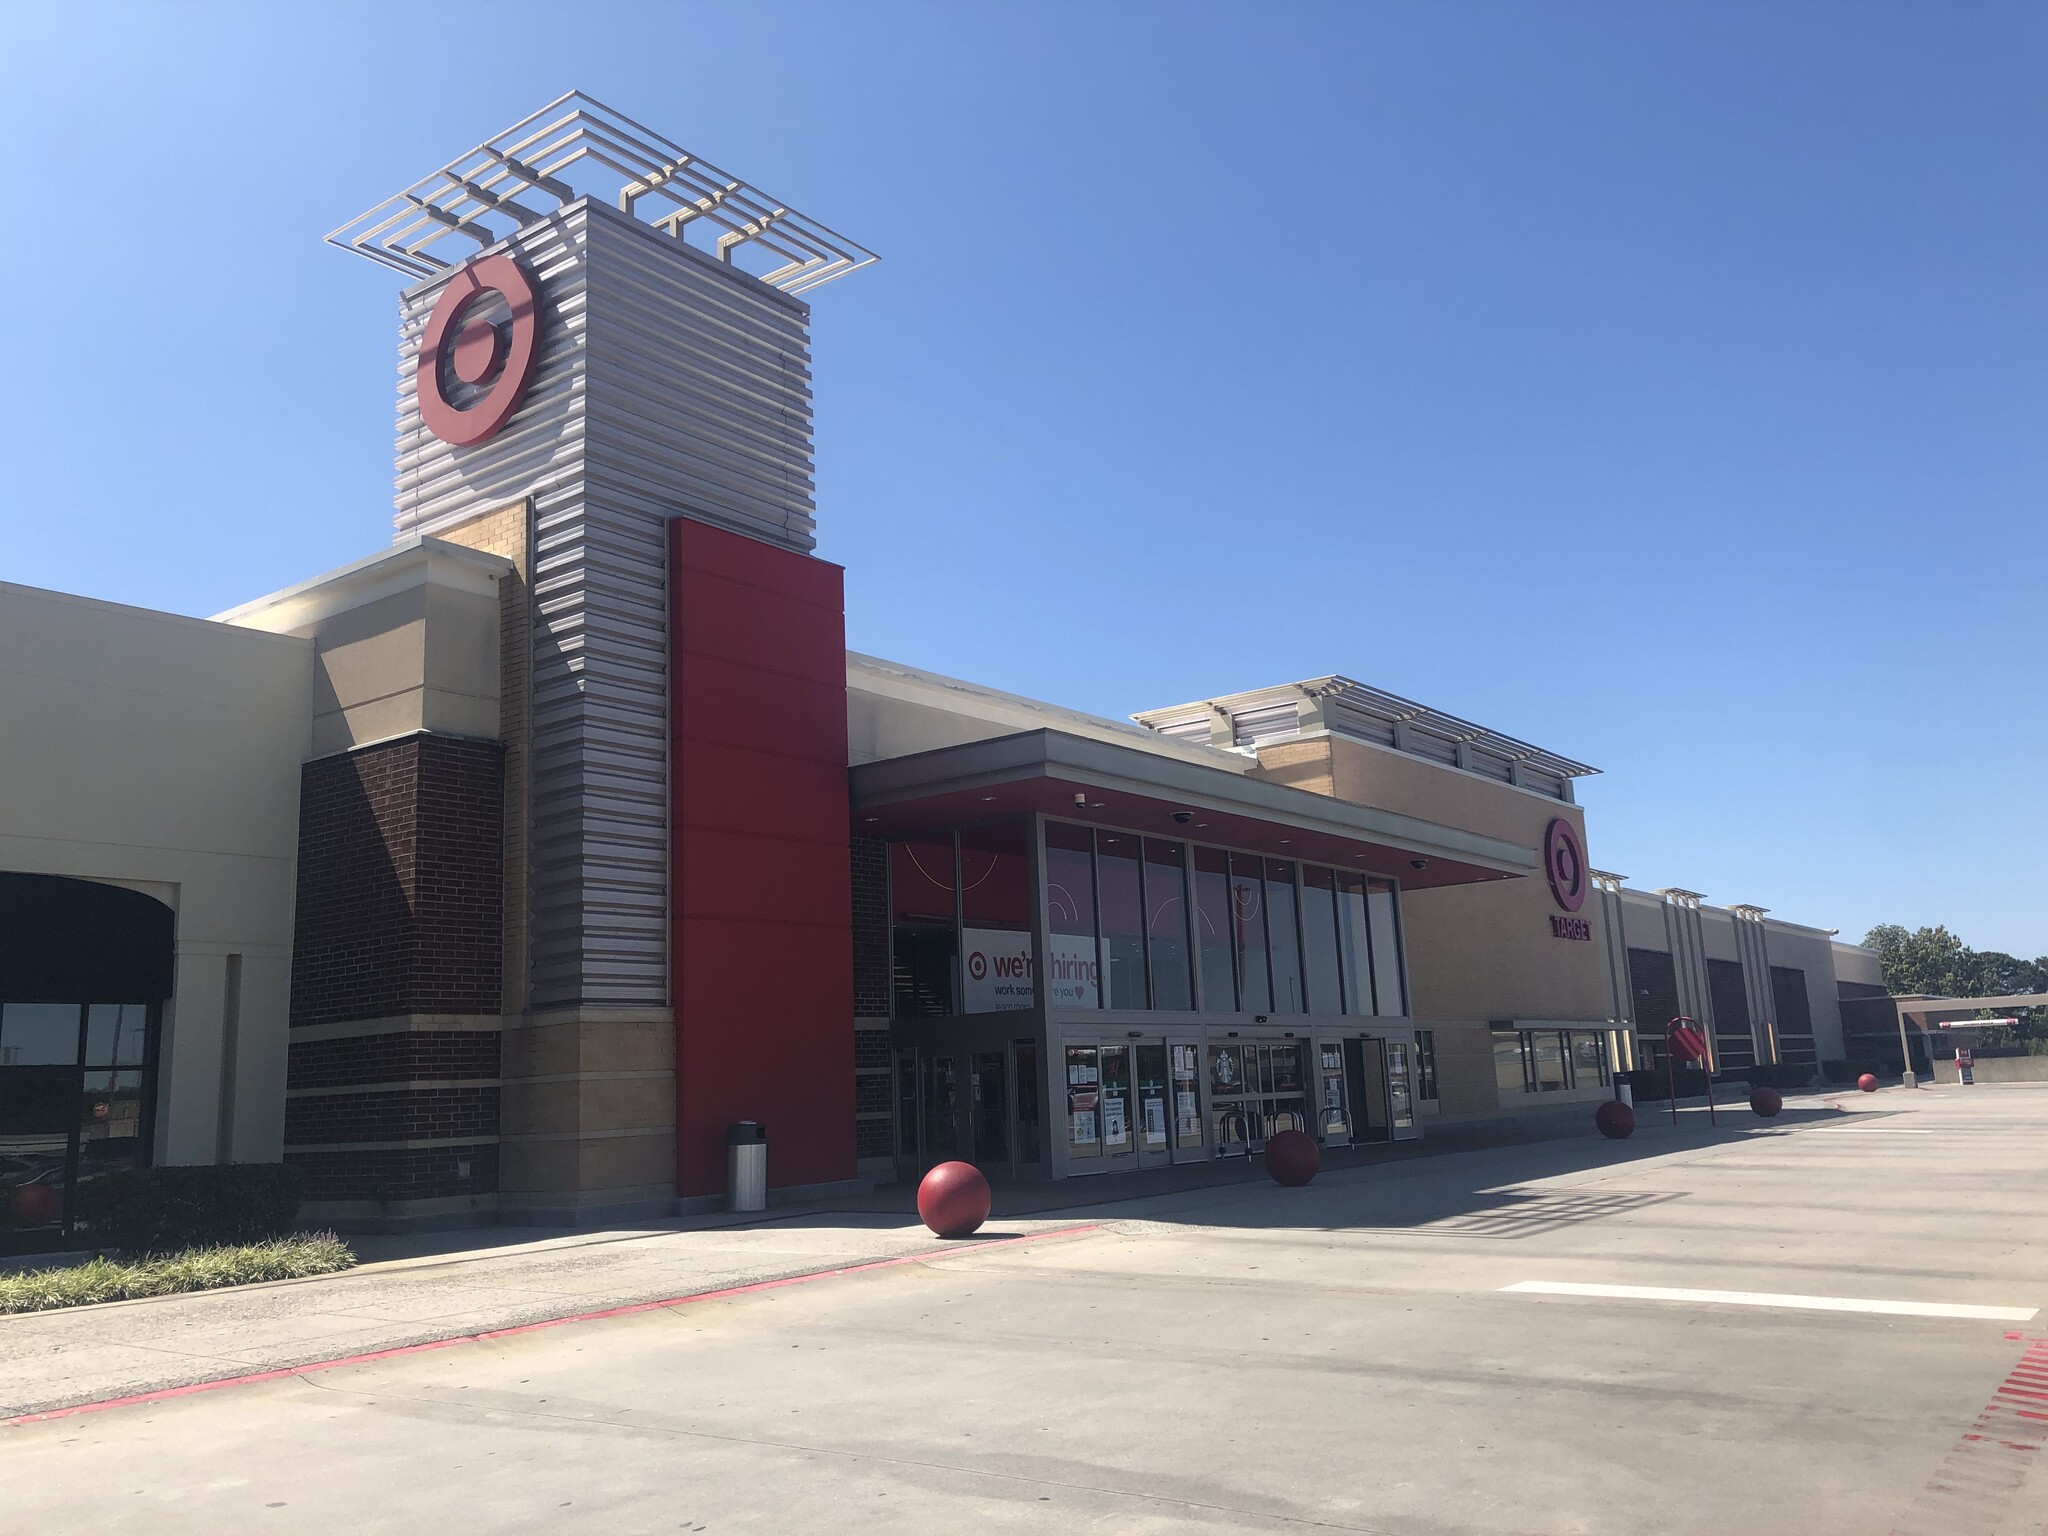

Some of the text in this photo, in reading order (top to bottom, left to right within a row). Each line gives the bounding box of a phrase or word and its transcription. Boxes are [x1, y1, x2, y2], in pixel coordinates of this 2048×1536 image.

[1551, 915, 1591, 941] TARGET
[992, 950, 1034, 978] we'r
[994, 984, 1015, 996] work
[1059, 988, 1074, 999] you
